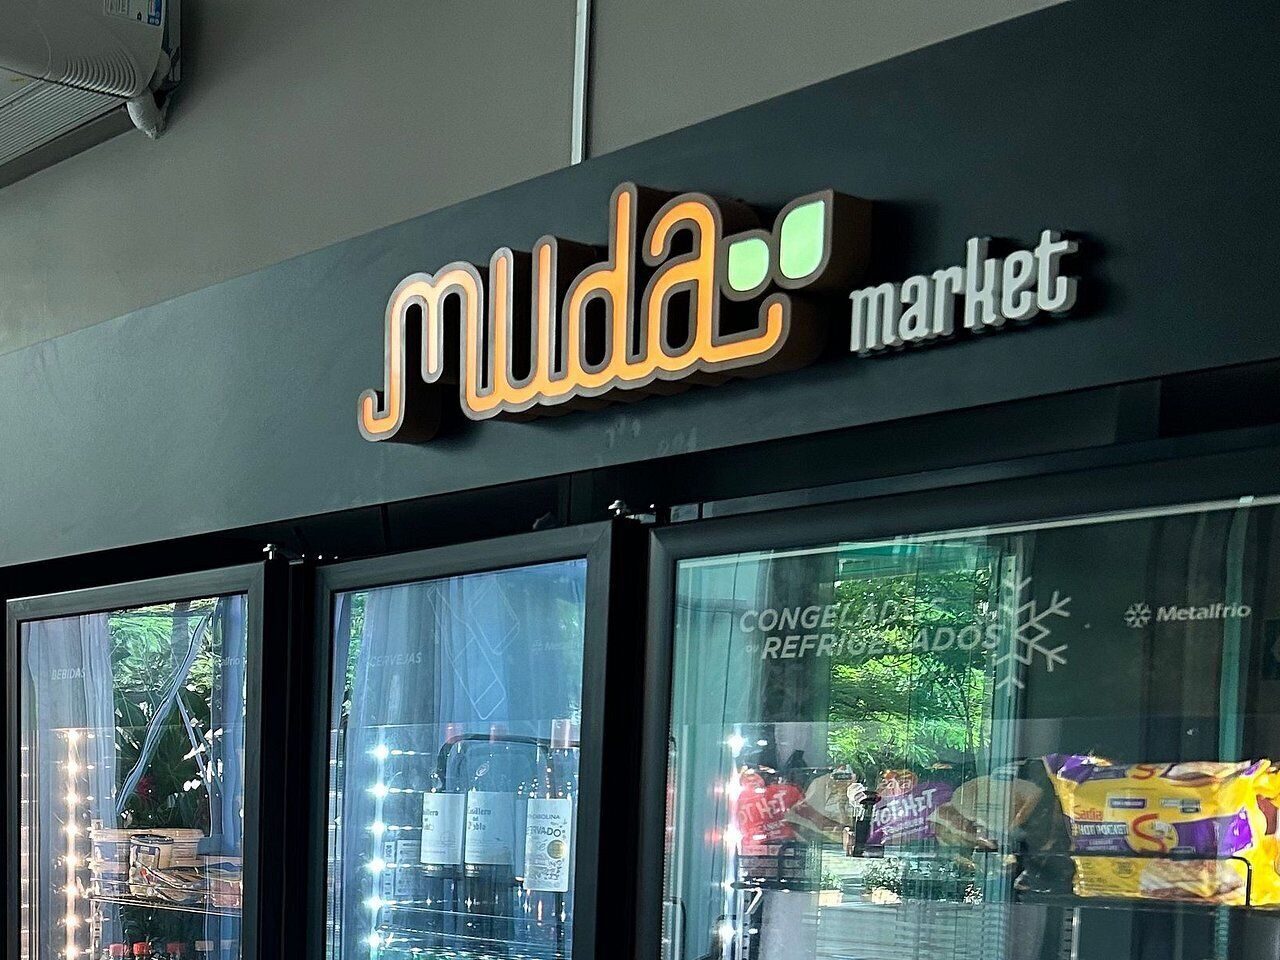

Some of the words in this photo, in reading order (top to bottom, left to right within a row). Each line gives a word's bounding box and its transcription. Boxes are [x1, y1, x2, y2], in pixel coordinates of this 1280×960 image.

[357, 181, 791, 441] muda
[849, 228, 1080, 355] market
[1156, 600, 1252, 622] Metalfrio
[761, 621, 1006, 661] REFRIGERADOS
[370, 651, 422, 668] CERVEJAS
[1073, 805, 1104, 821] Sadia
